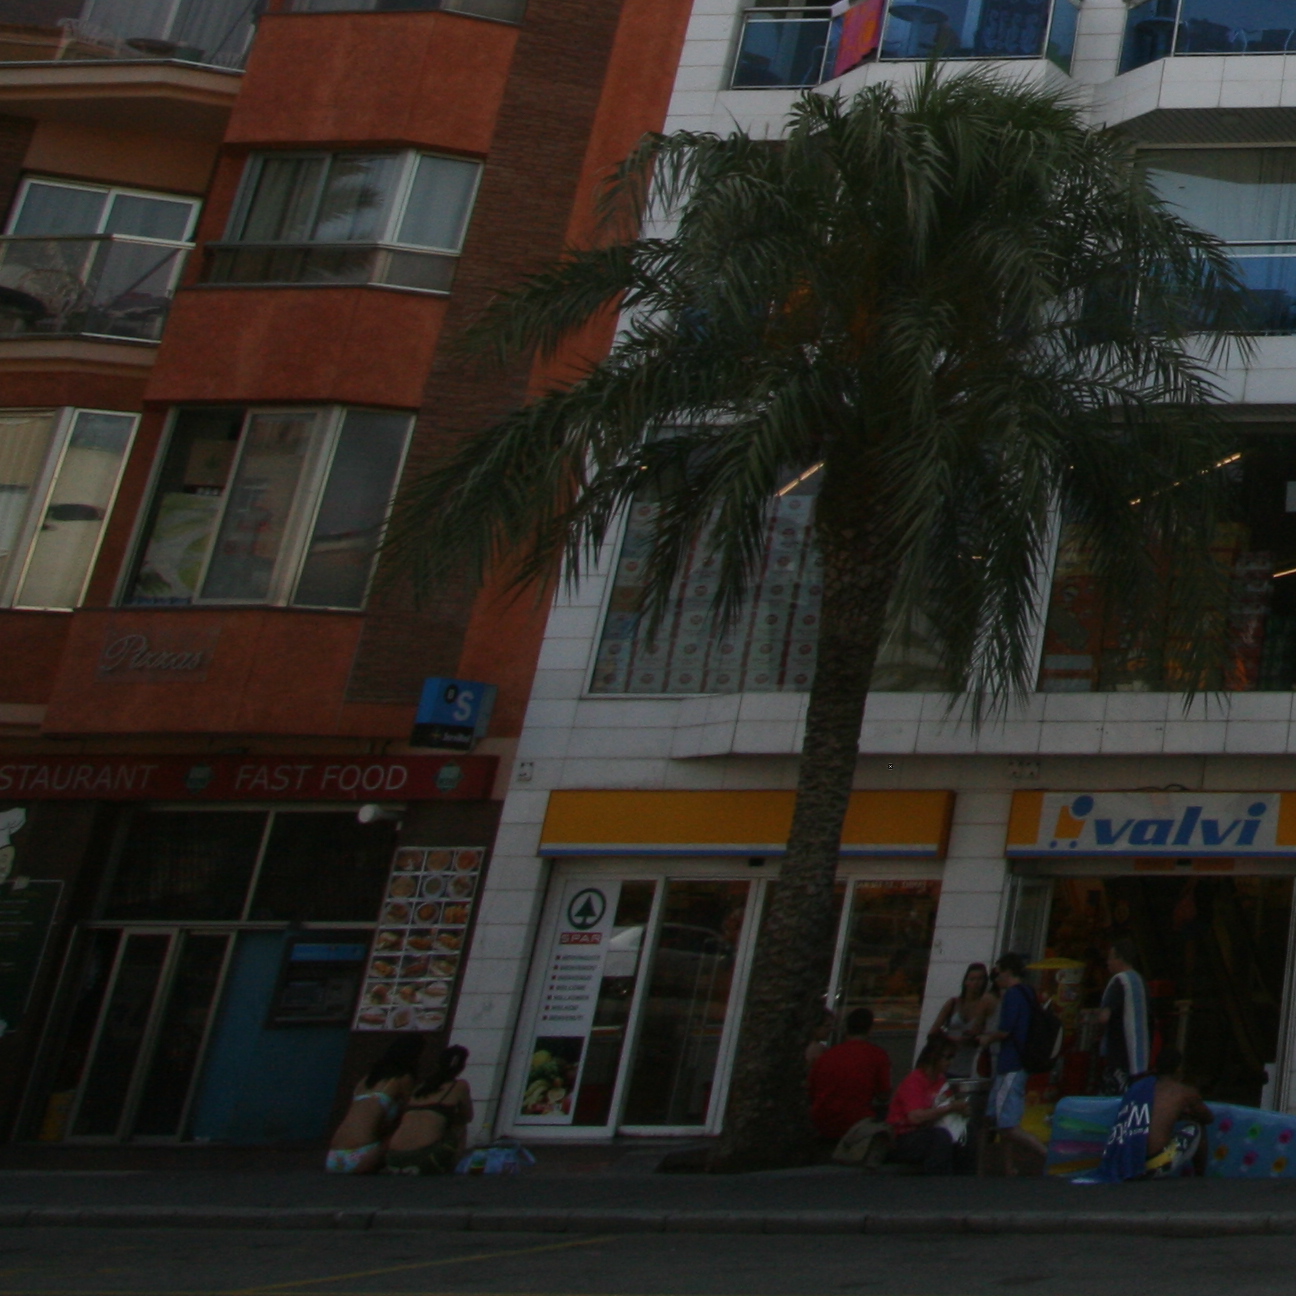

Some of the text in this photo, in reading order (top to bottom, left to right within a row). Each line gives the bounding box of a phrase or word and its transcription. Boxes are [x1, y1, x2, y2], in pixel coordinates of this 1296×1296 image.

[233, 763, 308, 791] FAST
[319, 763, 409, 791] FOOD
[1094, 801, 1267, 846] valvi
[560, 933, 602, 944] SPAR
